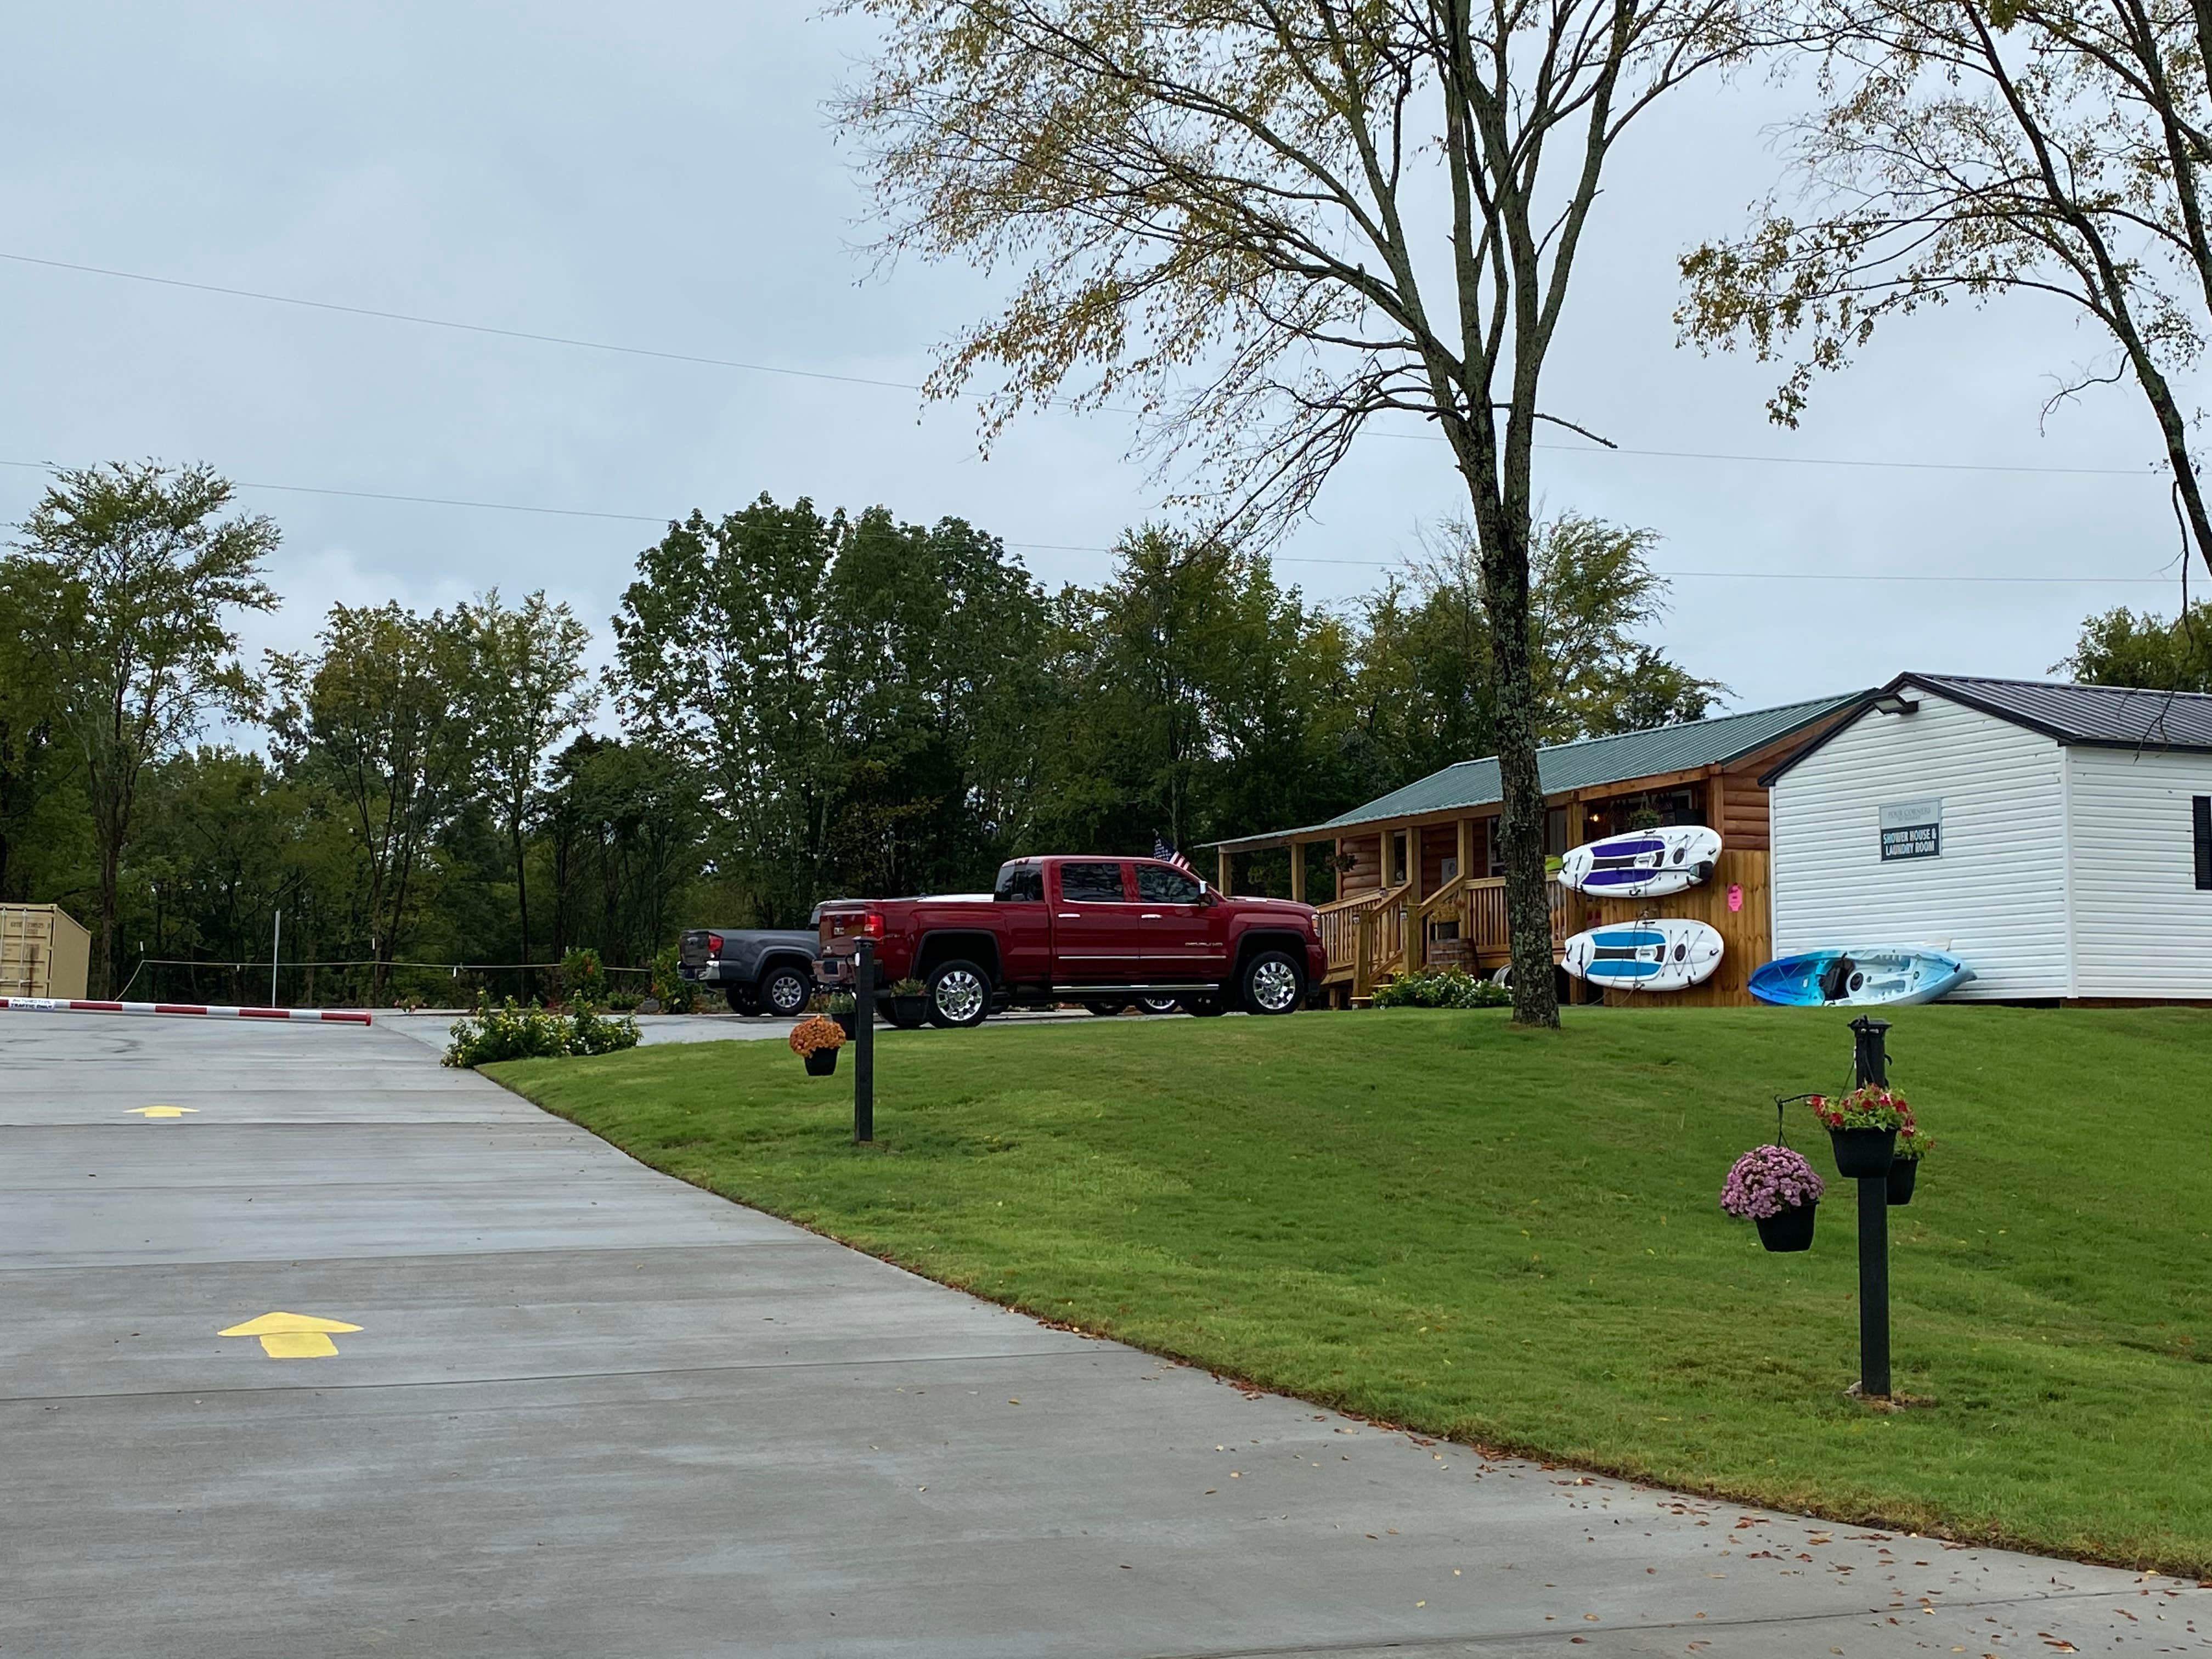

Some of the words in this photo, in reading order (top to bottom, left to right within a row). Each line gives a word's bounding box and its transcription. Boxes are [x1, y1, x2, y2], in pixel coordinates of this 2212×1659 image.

[1904, 807, 1931, 816] CORNERS
[1883, 831, 1909, 844] SHOWER
[1910, 829, 1931, 841] HOUSE
[1932, 828, 1936, 839] &
[1886, 843, 1914, 856] LAUNDRY
[1915, 840, 1934, 853] ROOM
